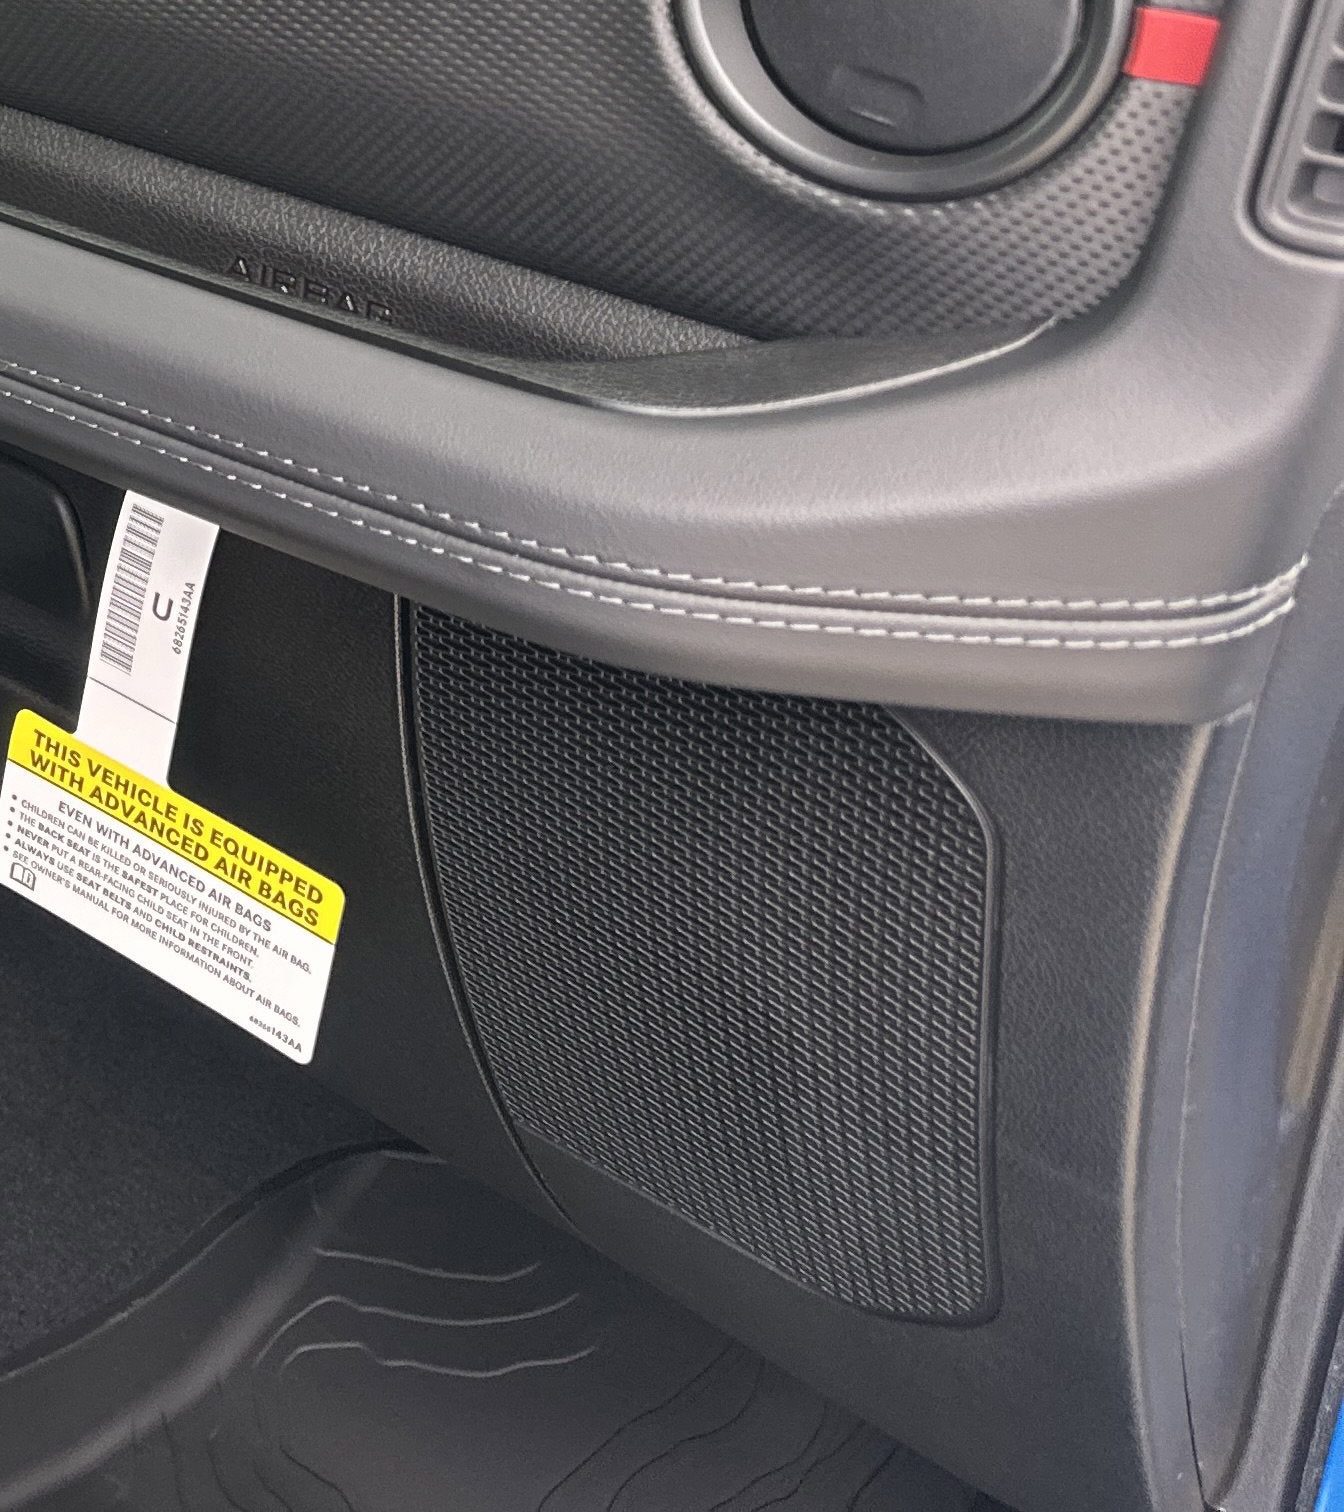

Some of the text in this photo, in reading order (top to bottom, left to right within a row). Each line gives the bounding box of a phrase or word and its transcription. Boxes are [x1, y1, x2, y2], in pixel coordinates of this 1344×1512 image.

[170, 581, 196, 656] 68265143AA
[19, 811, 35, 827] THE
[37, 822, 64, 844] BACK
[66, 838, 90, 859] SEAT
[101, 858, 119, 876] THE
[121, 869, 158, 899] SAFEST
[159, 891, 188, 916] PLACE
[190, 909, 209, 928] FOR
[210, 920, 260, 957] CHILDREN.
[20, 798, 65, 831] CHILDREN
[66, 824, 85, 843] CAN
[100, 844, 131, 869] KILLED
[147, 871, 197, 907] SERIOUSLY
[197, 900, 237, 930] INJURED
[251, 931, 271, 950] THE
[272, 943, 288, 960] AIR
[290, 953, 312, 974] BAG.
[28, 749, 319, 928] WITH ADVANCED AIR BAGS
[31, 728, 324, 907] THIS VEHICLE IS EQUIPPED
[58, 800, 272, 933] EVEN WITH ADVANCED AIR BAGS
[14, 836, 252, 982] ALWAYS USE SEAT BELTS AND CHILD RESTRAINTS.
